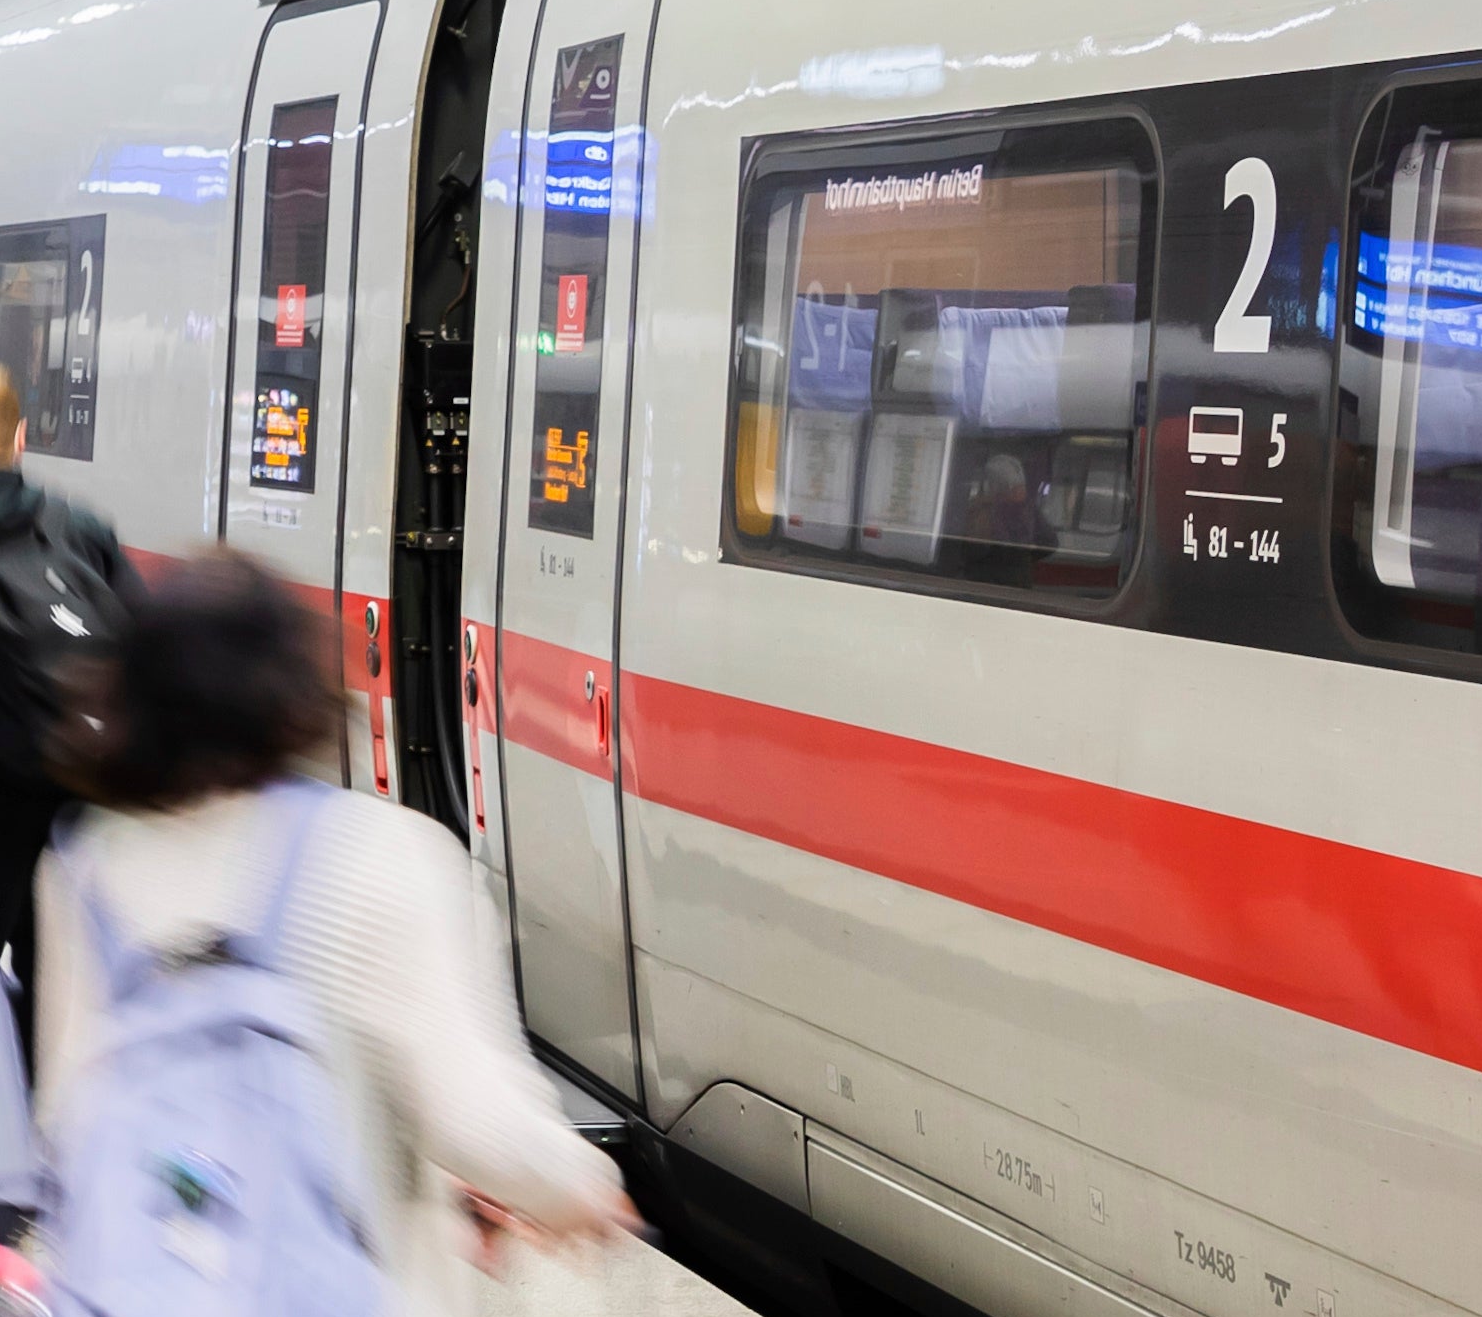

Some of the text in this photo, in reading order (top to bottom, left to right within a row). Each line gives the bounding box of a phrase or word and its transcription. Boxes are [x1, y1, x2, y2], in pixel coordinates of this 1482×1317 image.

[1213, 157, 1278, 353] 2
[78, 249, 92, 335] 2
[1267, 413, 1289, 469] 5
[1207, 513, 1228, 559] 81
[1248, 529, 1281, 564] 144
[1174, 1230, 1236, 1283] Tz 9458
